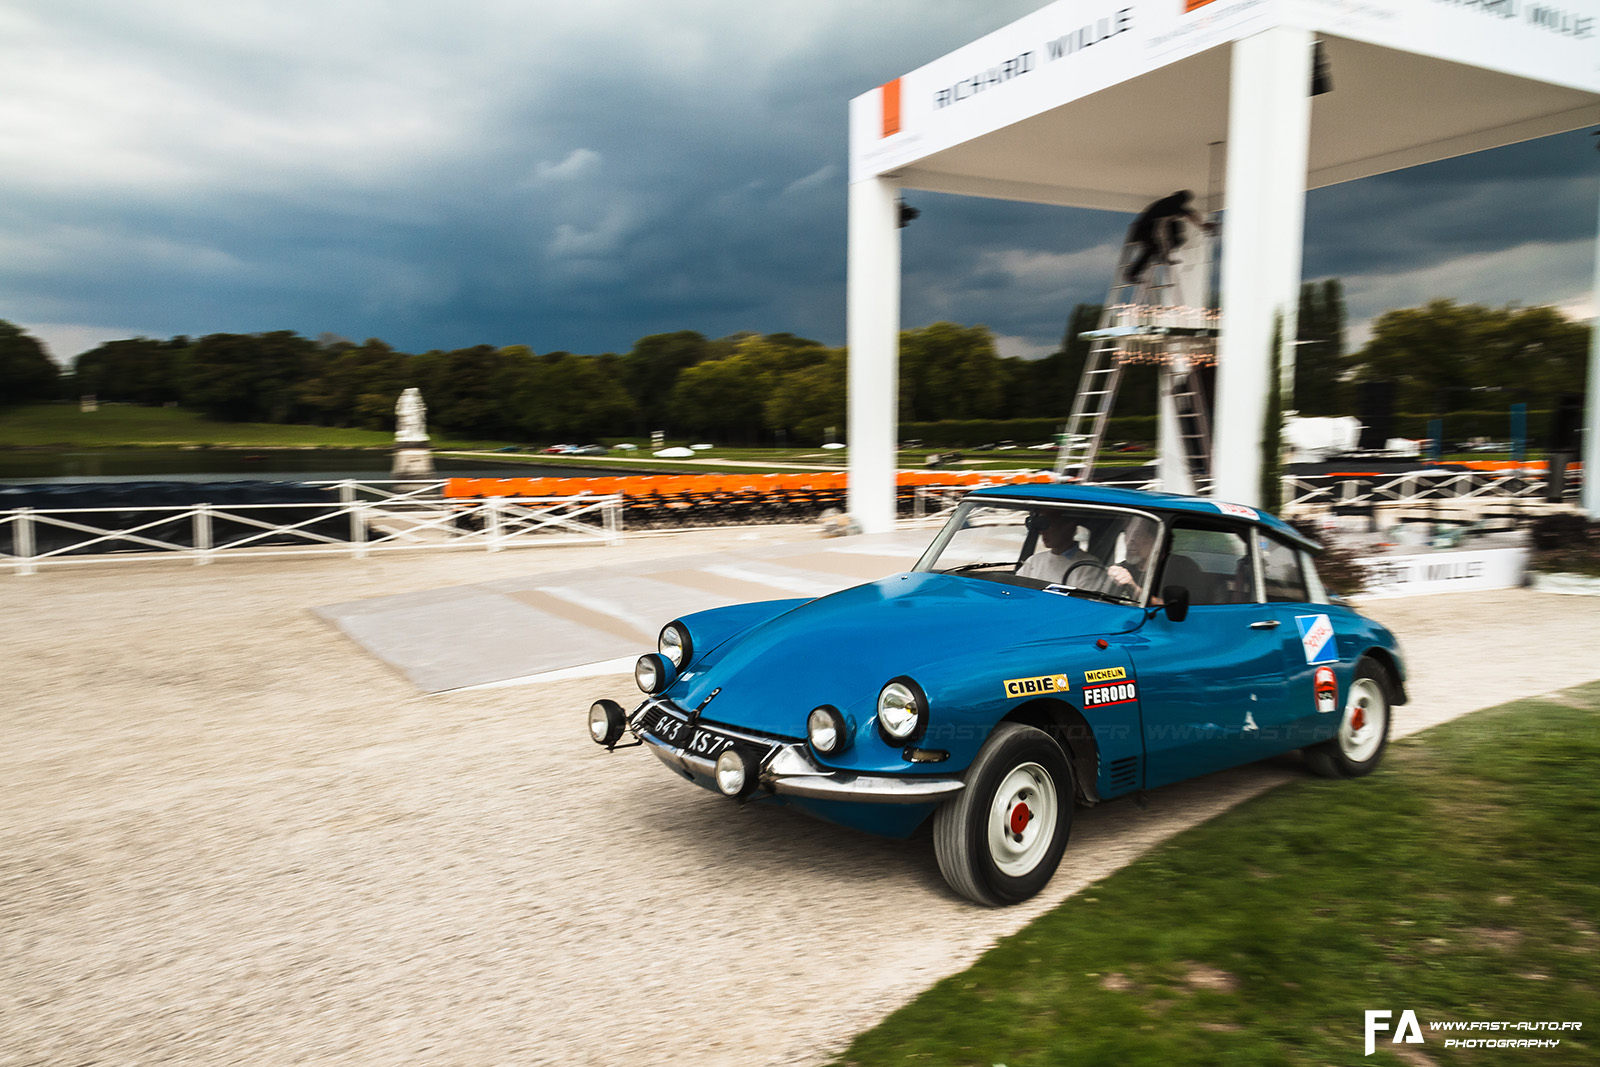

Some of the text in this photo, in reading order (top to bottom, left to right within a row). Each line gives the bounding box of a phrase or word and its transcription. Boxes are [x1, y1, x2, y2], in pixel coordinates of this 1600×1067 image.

[1086, 668, 1124, 681] MICHELIN
[1084, 683, 1136, 706] FERODO
[655, 716, 683, 740] 643
